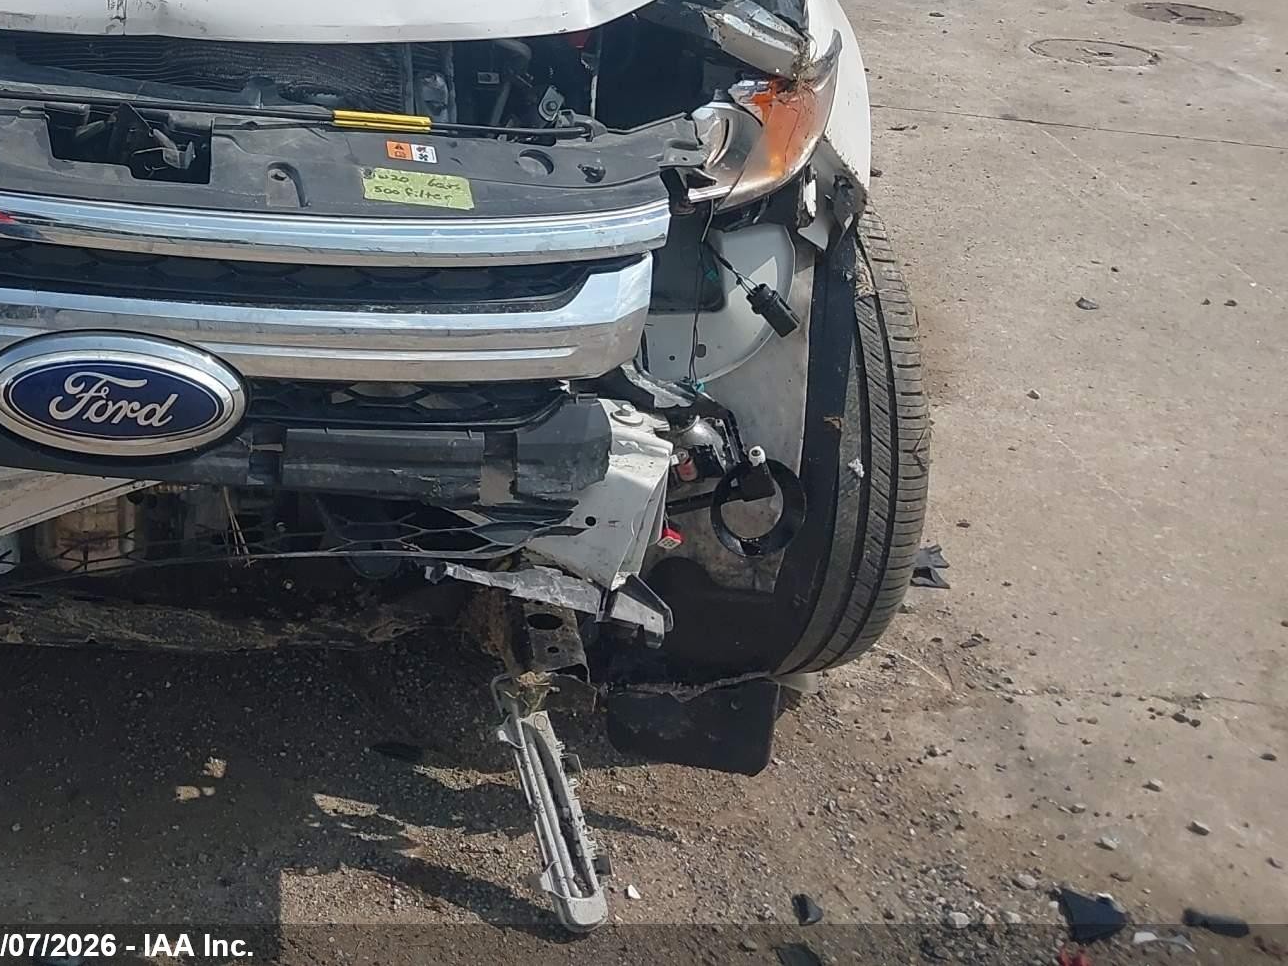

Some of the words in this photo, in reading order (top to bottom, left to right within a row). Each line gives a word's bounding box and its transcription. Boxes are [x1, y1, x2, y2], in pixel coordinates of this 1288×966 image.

[373, 185, 401, 195] 500
[404, 186, 454, 201] filter
[48, 371, 179, 427] Ford
